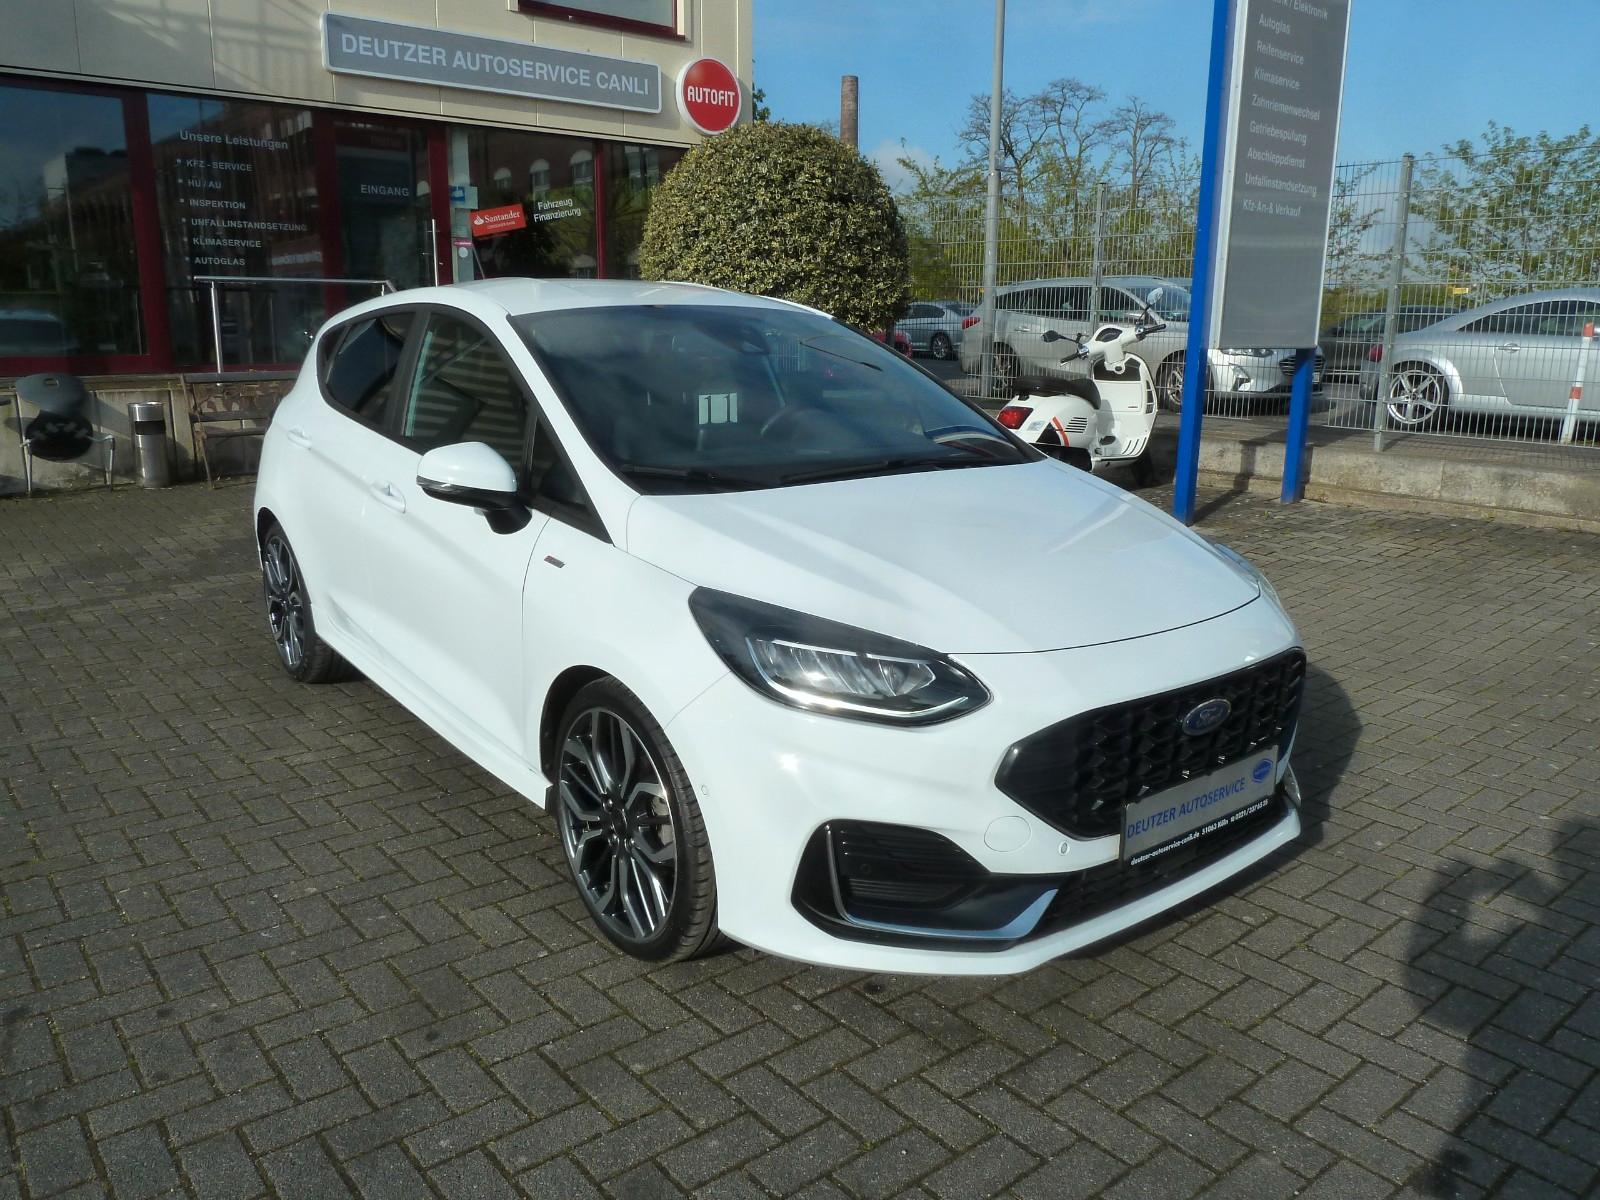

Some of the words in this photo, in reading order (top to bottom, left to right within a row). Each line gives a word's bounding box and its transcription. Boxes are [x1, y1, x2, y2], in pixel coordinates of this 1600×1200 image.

[1293, 0, 1329, 20] Elektronik
[1258, 13, 1291, 34] Autoglas
[1256, 40, 1304, 65] Reifenservice
[340, 33, 447, 66] DEUTZER
[451, 50, 591, 87] AUTOSERVICE
[596, 71, 650, 95] CANLI
[1254, 65, 1301, 90] Klimaservice
[687, 84, 737, 108] AUTOFIT
[1251, 93, 1321, 121] Zahnriemenwechsel
[179, 129, 222, 144] Unsere
[225, 135, 289, 151] Leistungen
[186, 159, 206, 168] KFZ
[212, 161, 253, 172] SERVICE
[1247, 147, 1306, 169] Abschleppdienst
[360, 184, 409, 197] EINGANG
[1245, 172, 1318, 198] Unfallinstandsetzung
[189, 199, 246, 209] INSPEKTION
[537, 198, 573, 211] Fahrzeug
[1275, 202, 1302, 218] Verkauf
[191, 218, 308, 232] UNFALLINSTANDSETZUNG
[484, 210, 520, 224] Santander
[533, 207, 582, 223] Finanzierung
[192, 237, 262, 248] KLIMASERVICE
[194, 257, 246, 266] AUTOGLAS
[1126, 806, 1176, 839] DEUTZER
[1178, 777, 1246, 816] AUTOSERVICE
